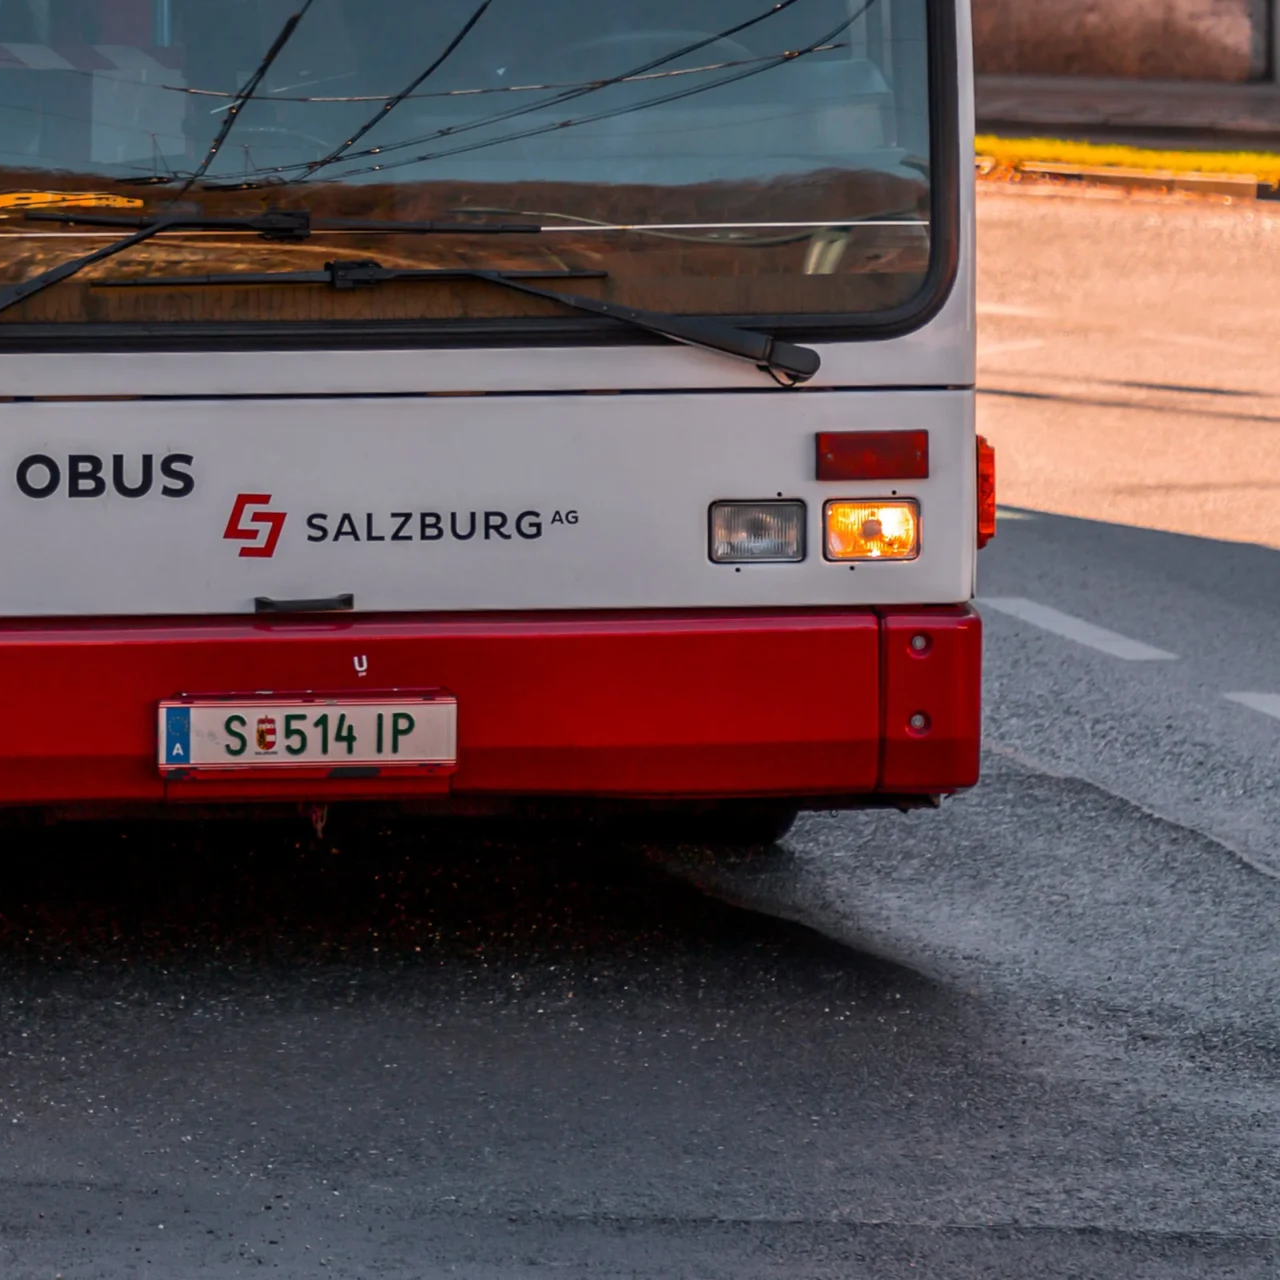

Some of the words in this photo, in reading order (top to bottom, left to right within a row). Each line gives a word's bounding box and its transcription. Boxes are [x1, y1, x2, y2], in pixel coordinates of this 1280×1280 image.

[15, 453, 196, 499] OBUS
[305, 509, 544, 543] SALZBURG
[549, 509, 580, 525] AG
[171, 742, 185, 757] A
